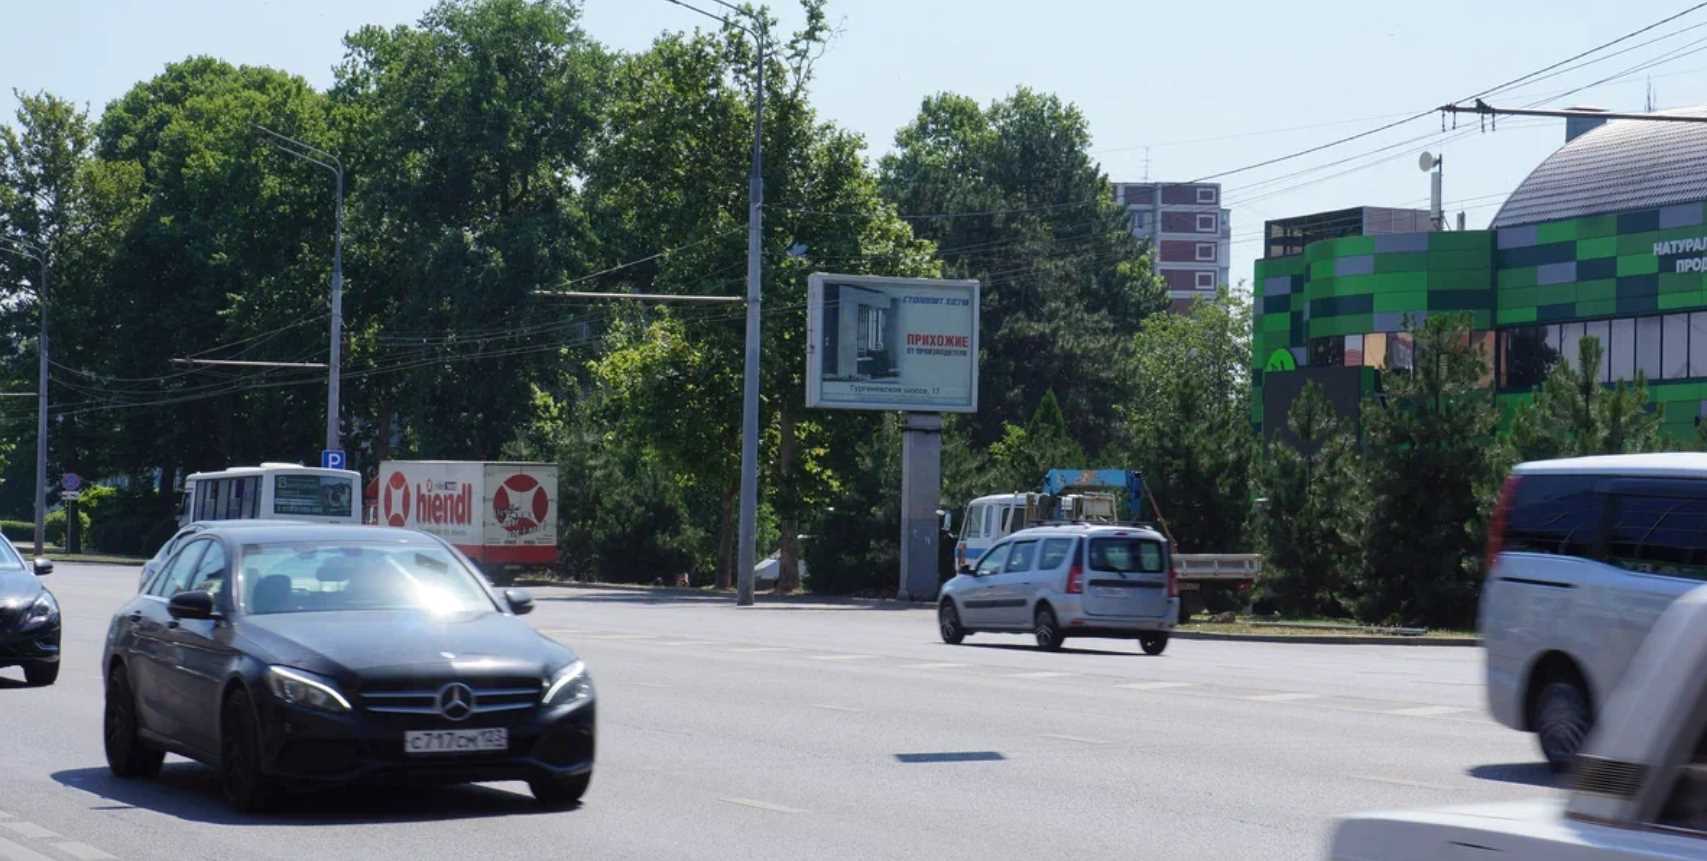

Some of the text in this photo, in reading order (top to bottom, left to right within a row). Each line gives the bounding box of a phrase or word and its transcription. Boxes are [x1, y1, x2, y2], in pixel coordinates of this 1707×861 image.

[907, 334, 969, 348] ПРИХОЖИЕ
[328, 453, 341, 469] P
[416, 482, 473, 525] hiendl
